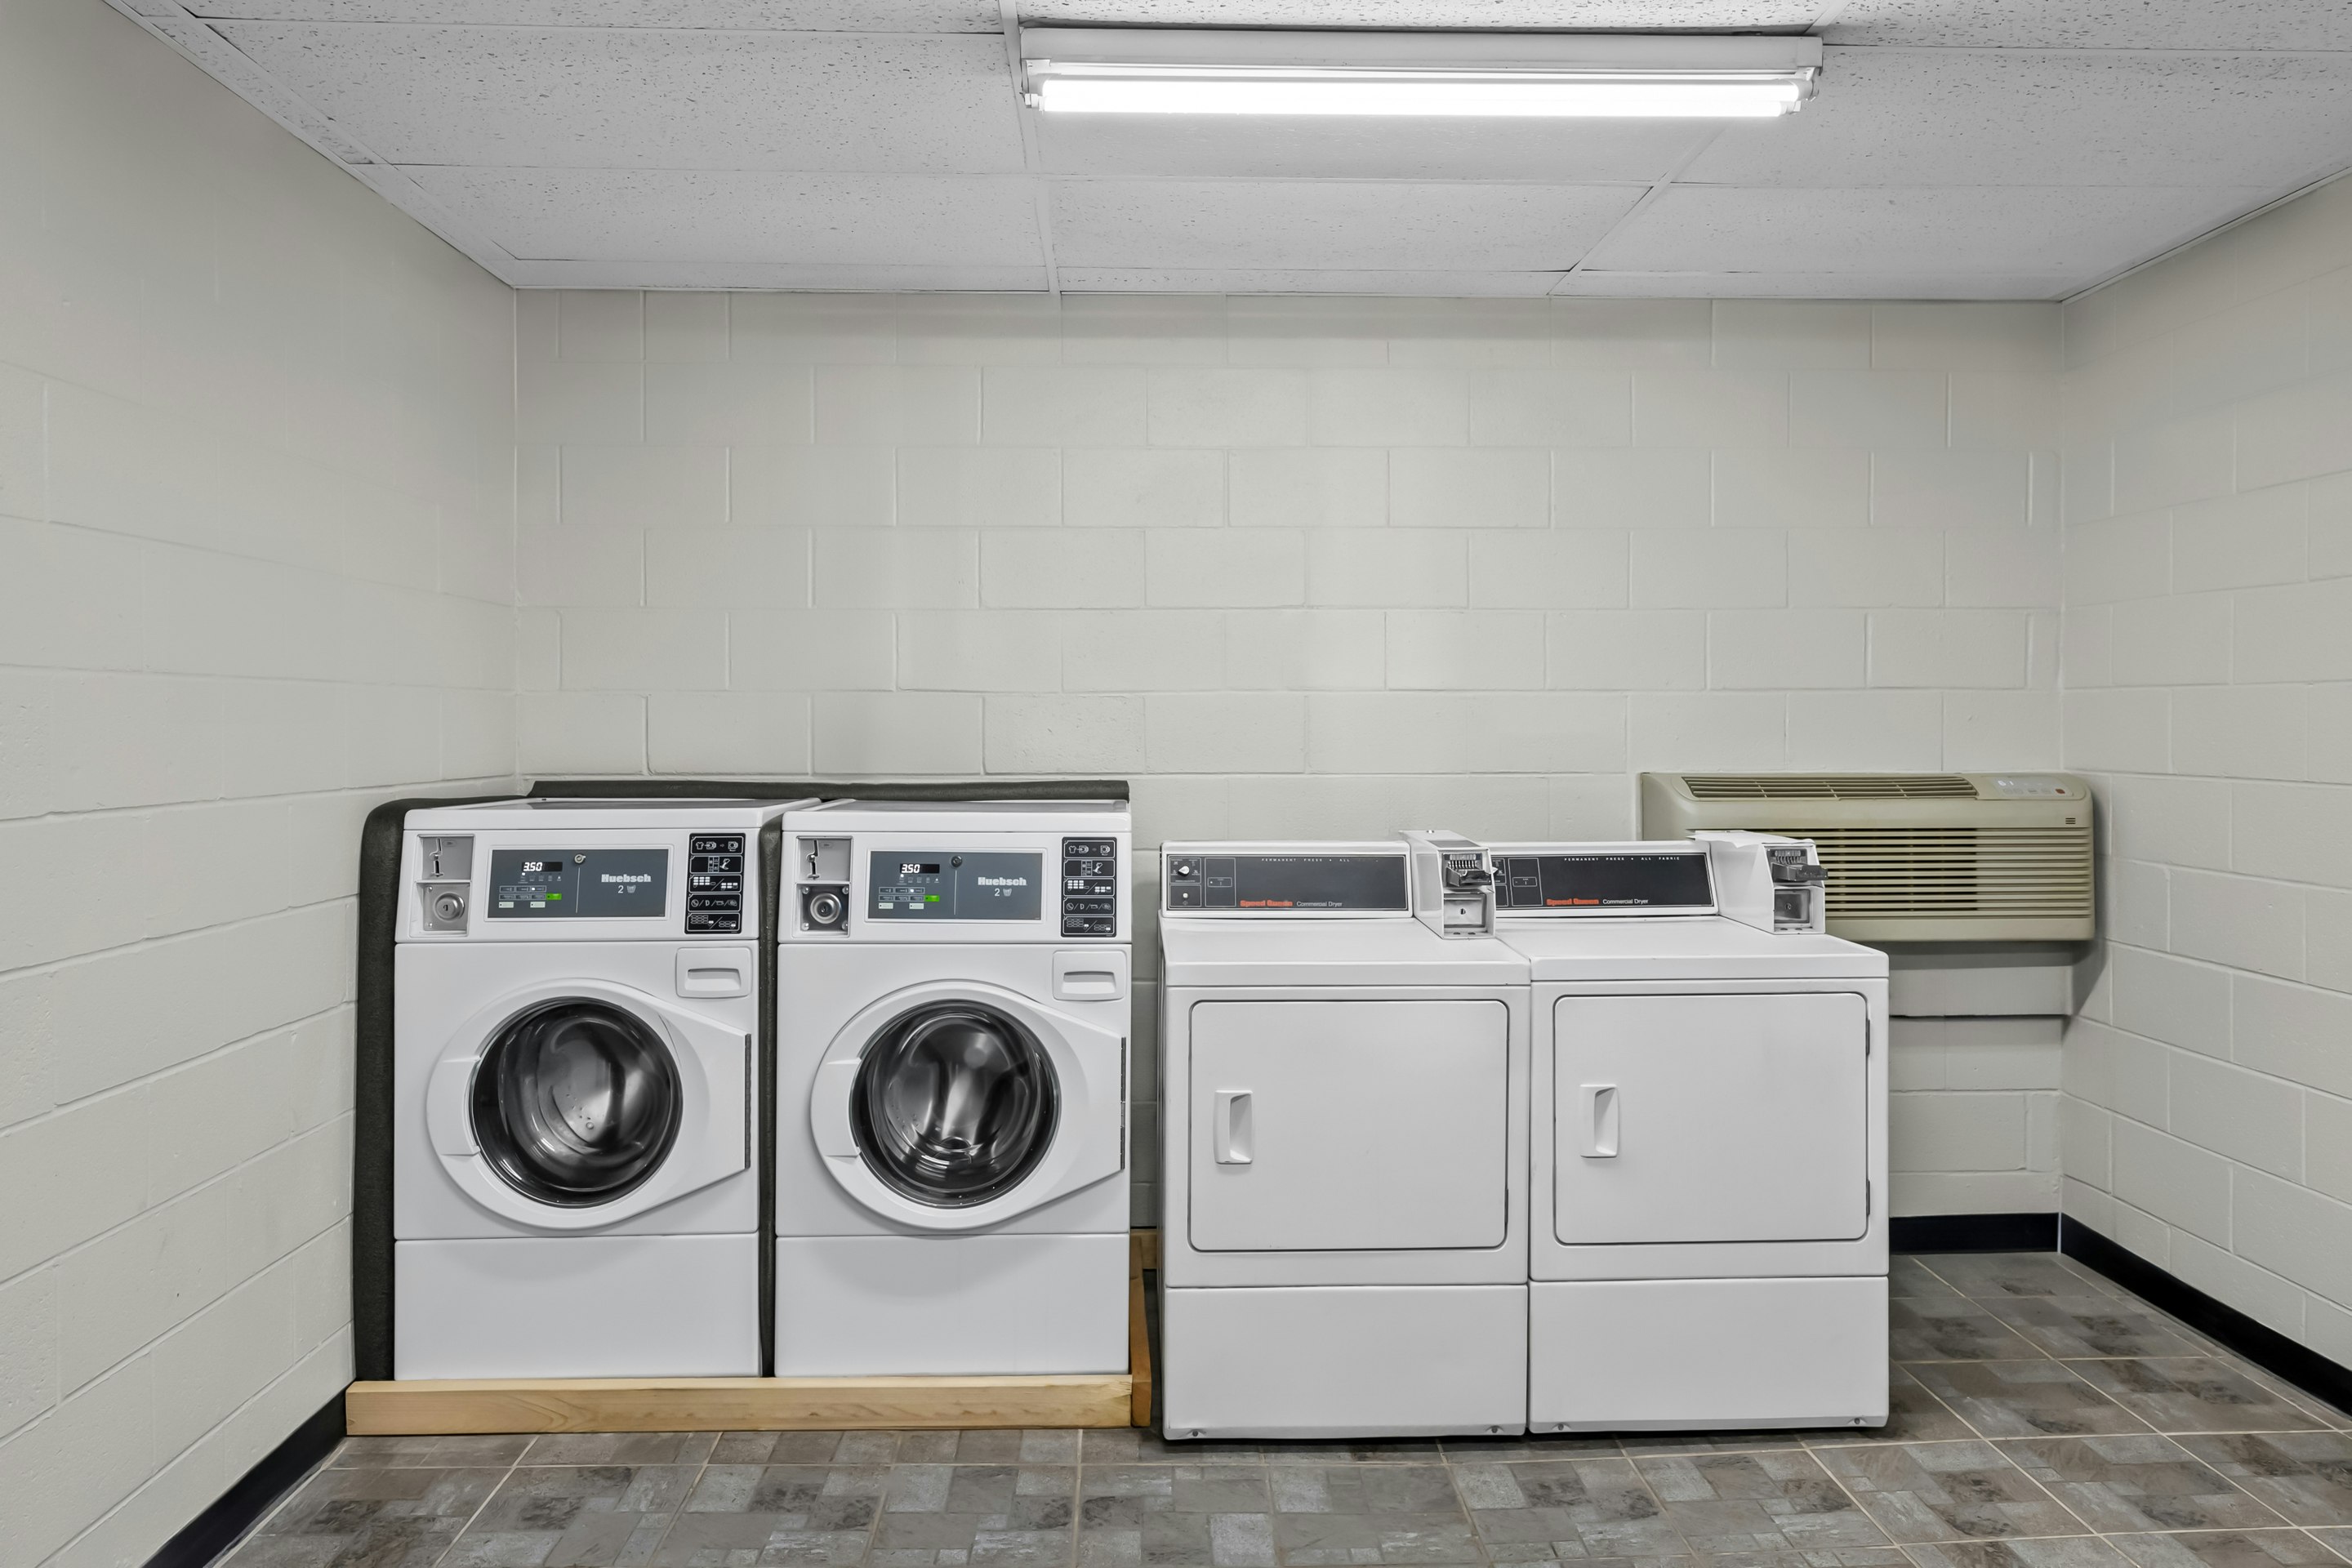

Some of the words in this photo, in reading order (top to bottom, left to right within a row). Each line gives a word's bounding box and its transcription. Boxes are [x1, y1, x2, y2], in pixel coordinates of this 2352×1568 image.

[523, 862, 542, 871] 3.50
[901, 863, 920, 873] 3.50
[601, 874, 652, 883] Huebsch
[978, 876, 1027, 886] Huebsch
[617, 884, 624, 893] 2
[994, 888, 1000, 897] 2
